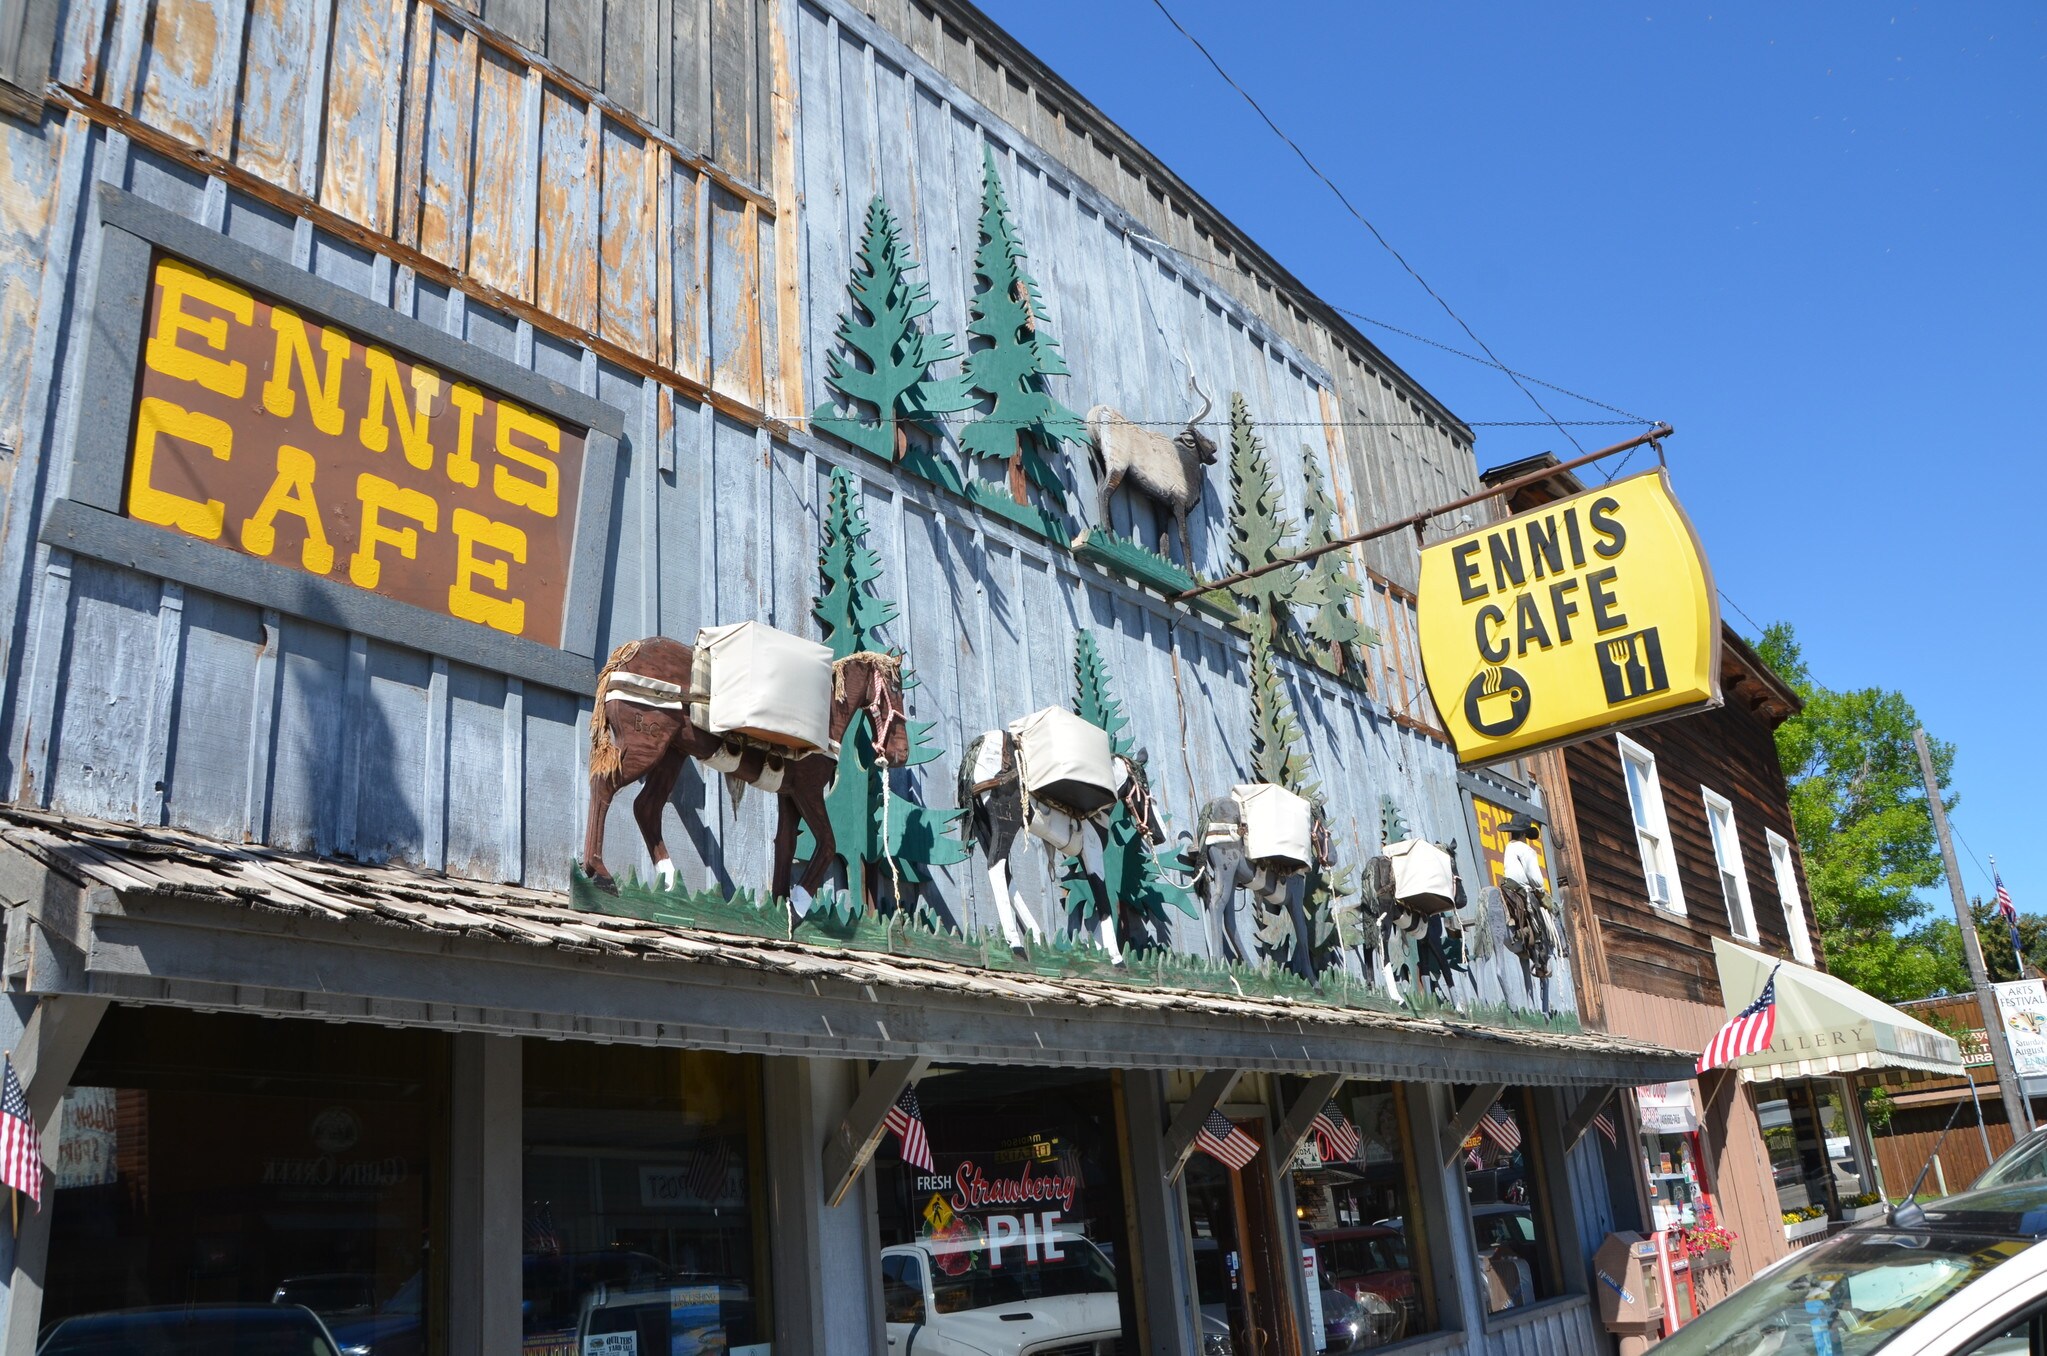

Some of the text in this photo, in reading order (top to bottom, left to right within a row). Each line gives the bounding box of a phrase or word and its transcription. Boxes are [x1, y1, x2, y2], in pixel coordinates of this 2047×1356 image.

[145, 257, 560, 517] ENNIS
[128, 396, 528, 635] CAFE
[1452, 496, 1627, 605] ENNIS
[1475, 566, 1628, 666] CAFE
[2000, 995, 2045, 1007] FESTIVAL
[2008, 985, 2034, 997] ARTS
[917, 1160, 1076, 1211] FRESH Strawberry
[987, 1211, 1066, 1269] PIE
